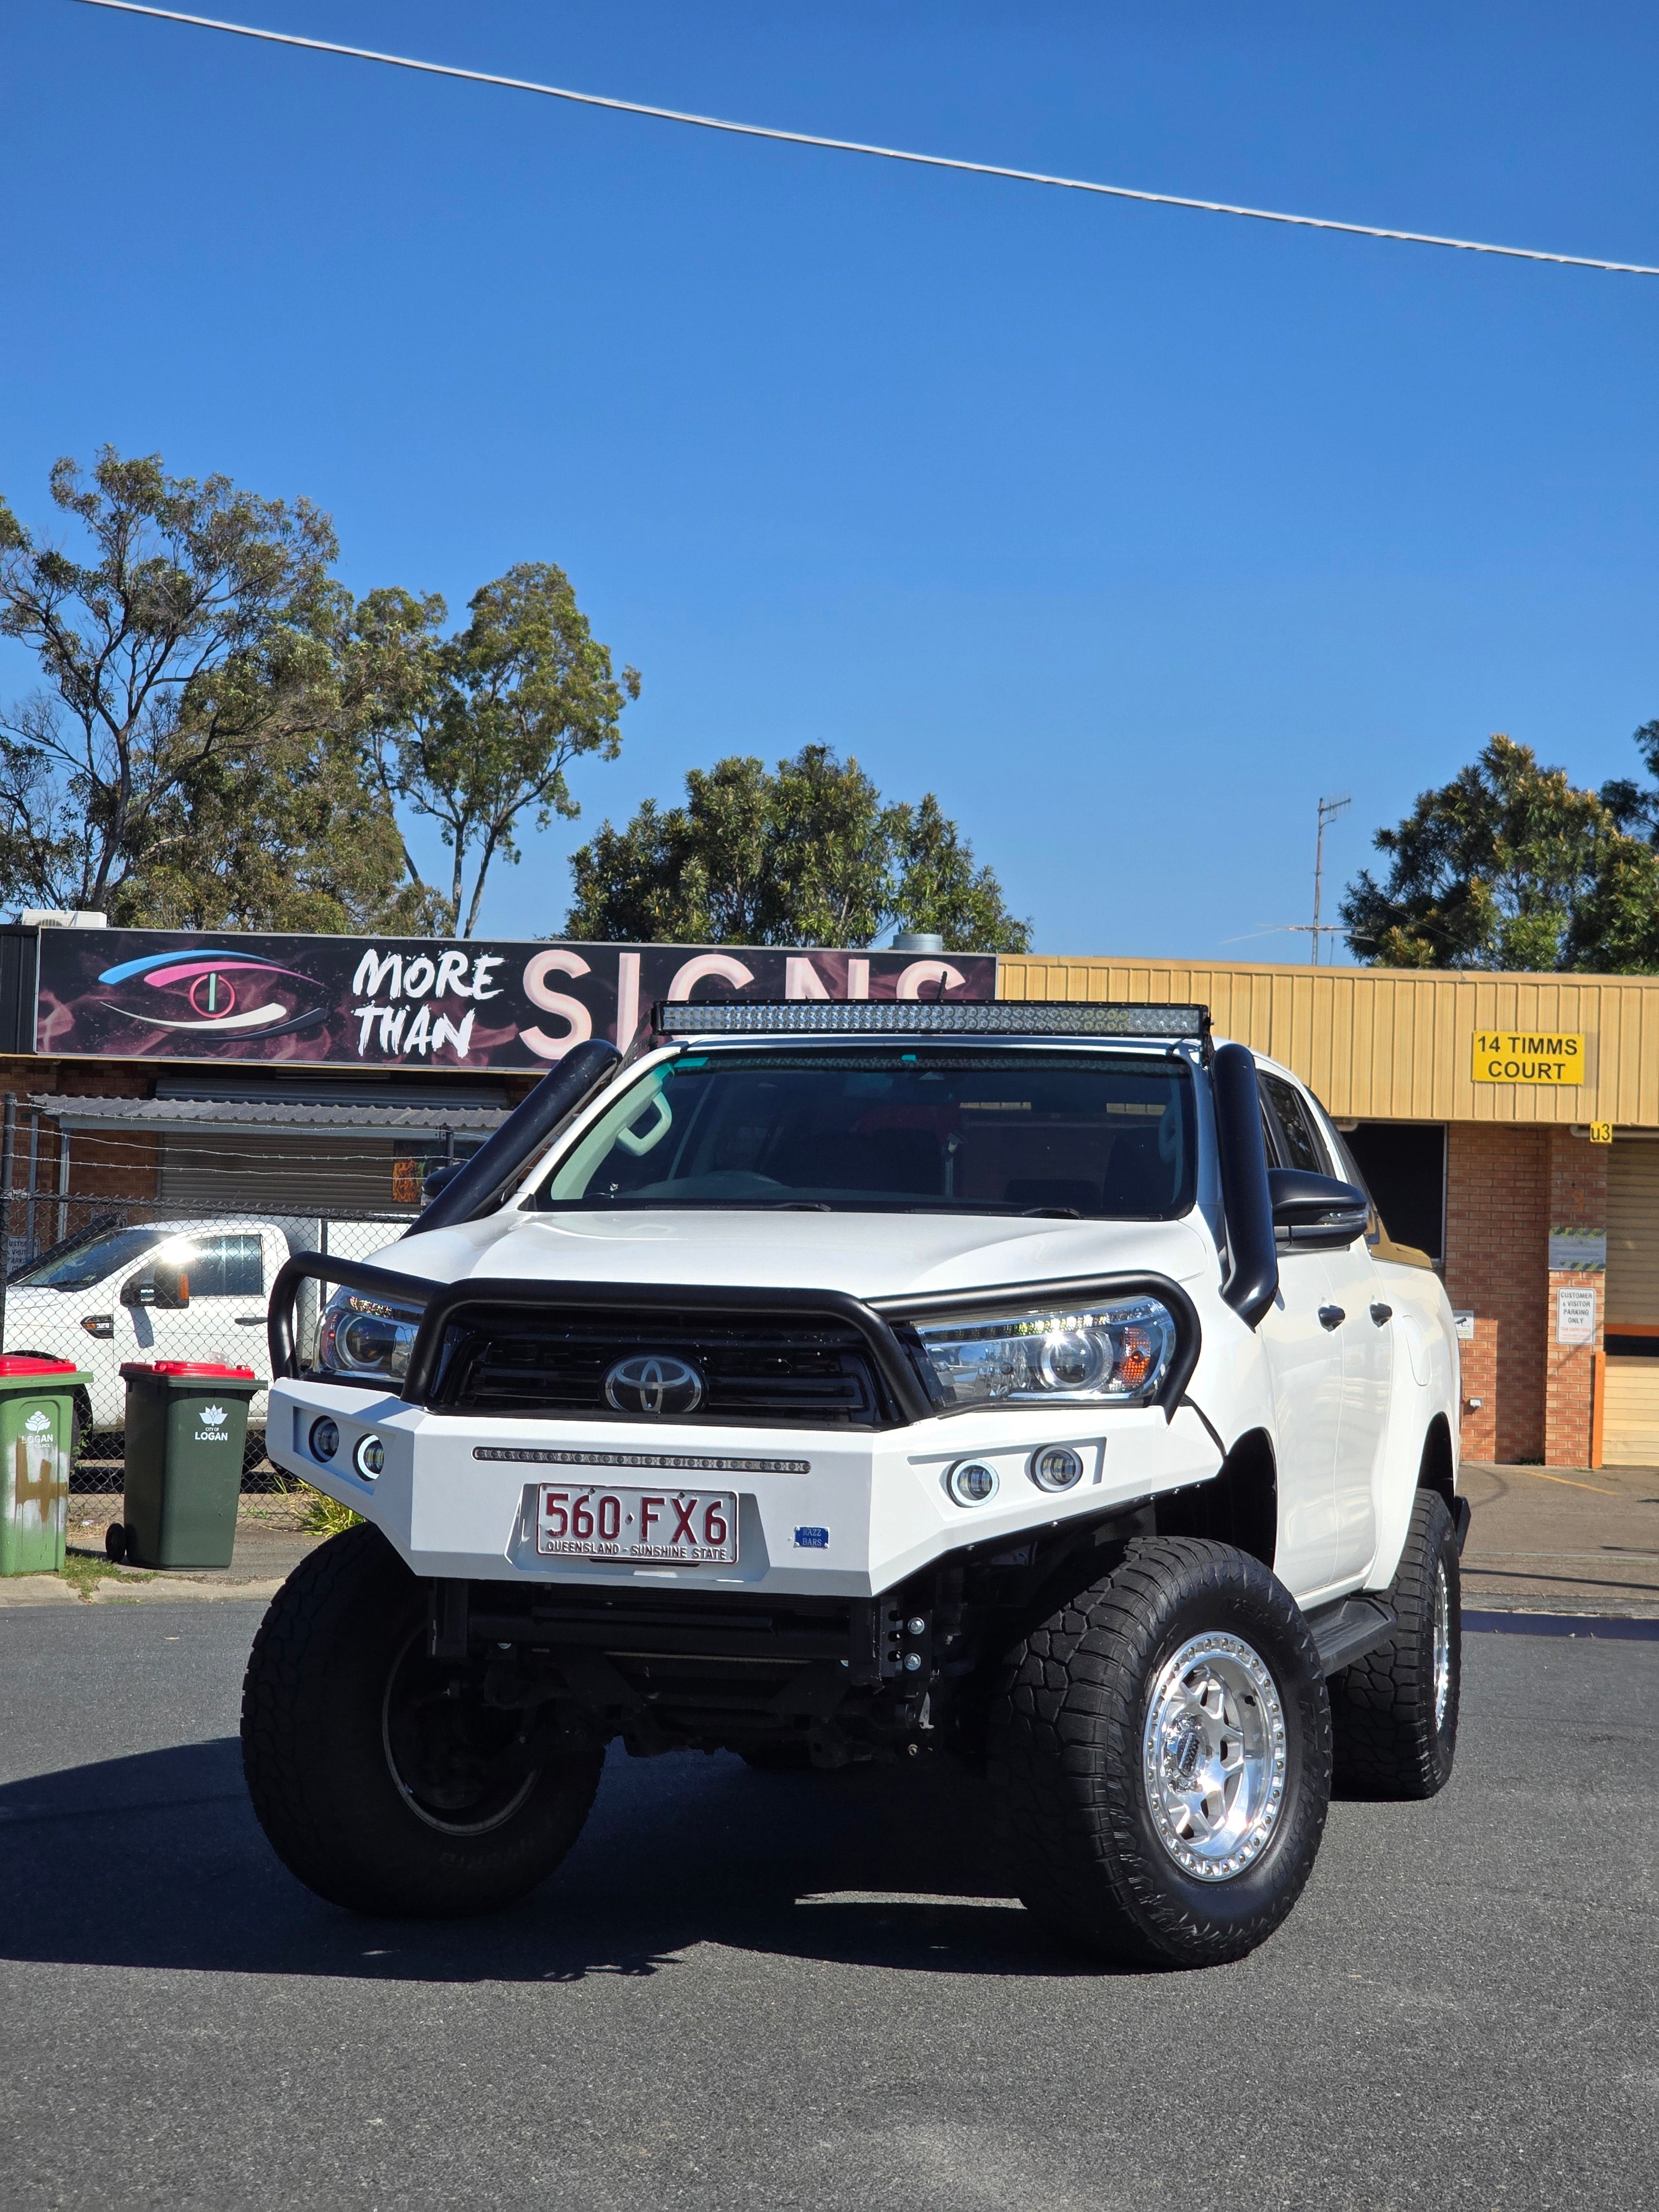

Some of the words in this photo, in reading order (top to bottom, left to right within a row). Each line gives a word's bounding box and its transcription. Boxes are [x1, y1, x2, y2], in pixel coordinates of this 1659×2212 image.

[352, 948, 505, 1000] MORE
[351, 1001, 476, 1058] THAN
[1478, 1036, 1500, 1052] 14
[1507, 1037, 1577, 1056] TIMMS
[1488, 1061, 1566, 1079] COURT
[1591, 1123, 1610, 1141] u3
[22, 1434, 53, 1443] LOGAN
[195, 1432, 228, 1441] LOGAN
[803, 1528, 822, 1536] RAZZ
[547, 1540, 620, 1555] QUEENSLAND
[630, 1544, 687, 1558] SUNSHINE
[692, 1547, 727, 1559] STATE
